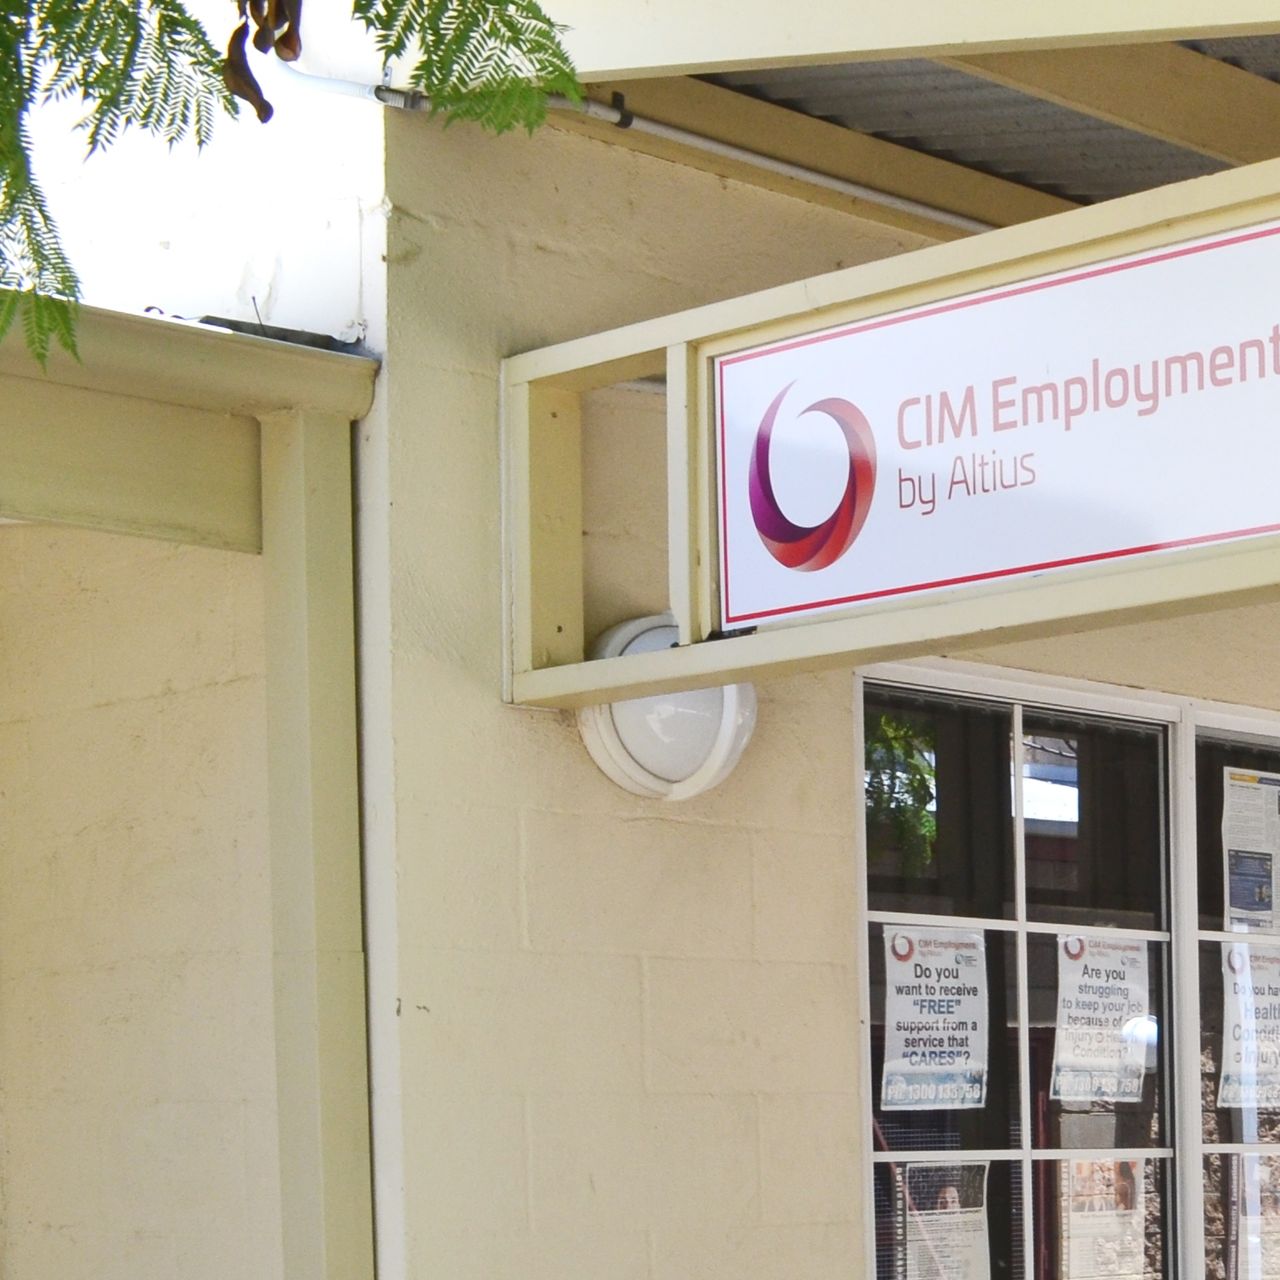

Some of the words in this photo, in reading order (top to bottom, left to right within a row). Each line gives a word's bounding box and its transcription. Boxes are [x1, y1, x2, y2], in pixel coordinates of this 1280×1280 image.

[897, 385, 978, 450] CIM
[898, 468, 936, 515] by
[948, 450, 1036, 499] Altius
[914, 963, 932, 979] Do
[935, 967, 959, 983] you
[1082, 964, 1101, 979] Are
[1105, 969, 1126, 983] you
[895, 984, 922, 996] want
[925, 984, 937, 996] to
[939, 985, 978, 997] receive
[1078, 984, 1129, 999] struggling
[1062, 998, 1073, 1010] to
[1075, 998, 1098, 1013] keep
[1102, 1001, 1125, 1014] your
[1127, 1000, 1143, 1015] job
[896, 1018, 939, 1035] support
[942, 1018, 968, 1032] from
[971, 1021, 977, 1032] a
[1067, 1014, 1109, 1027] because
[1112, 1015, 1123, 1027] of
[904, 1036, 944, 1048] service
[947, 1035, 969, 1048] that
[896, 1167, 904, 1241] Information
